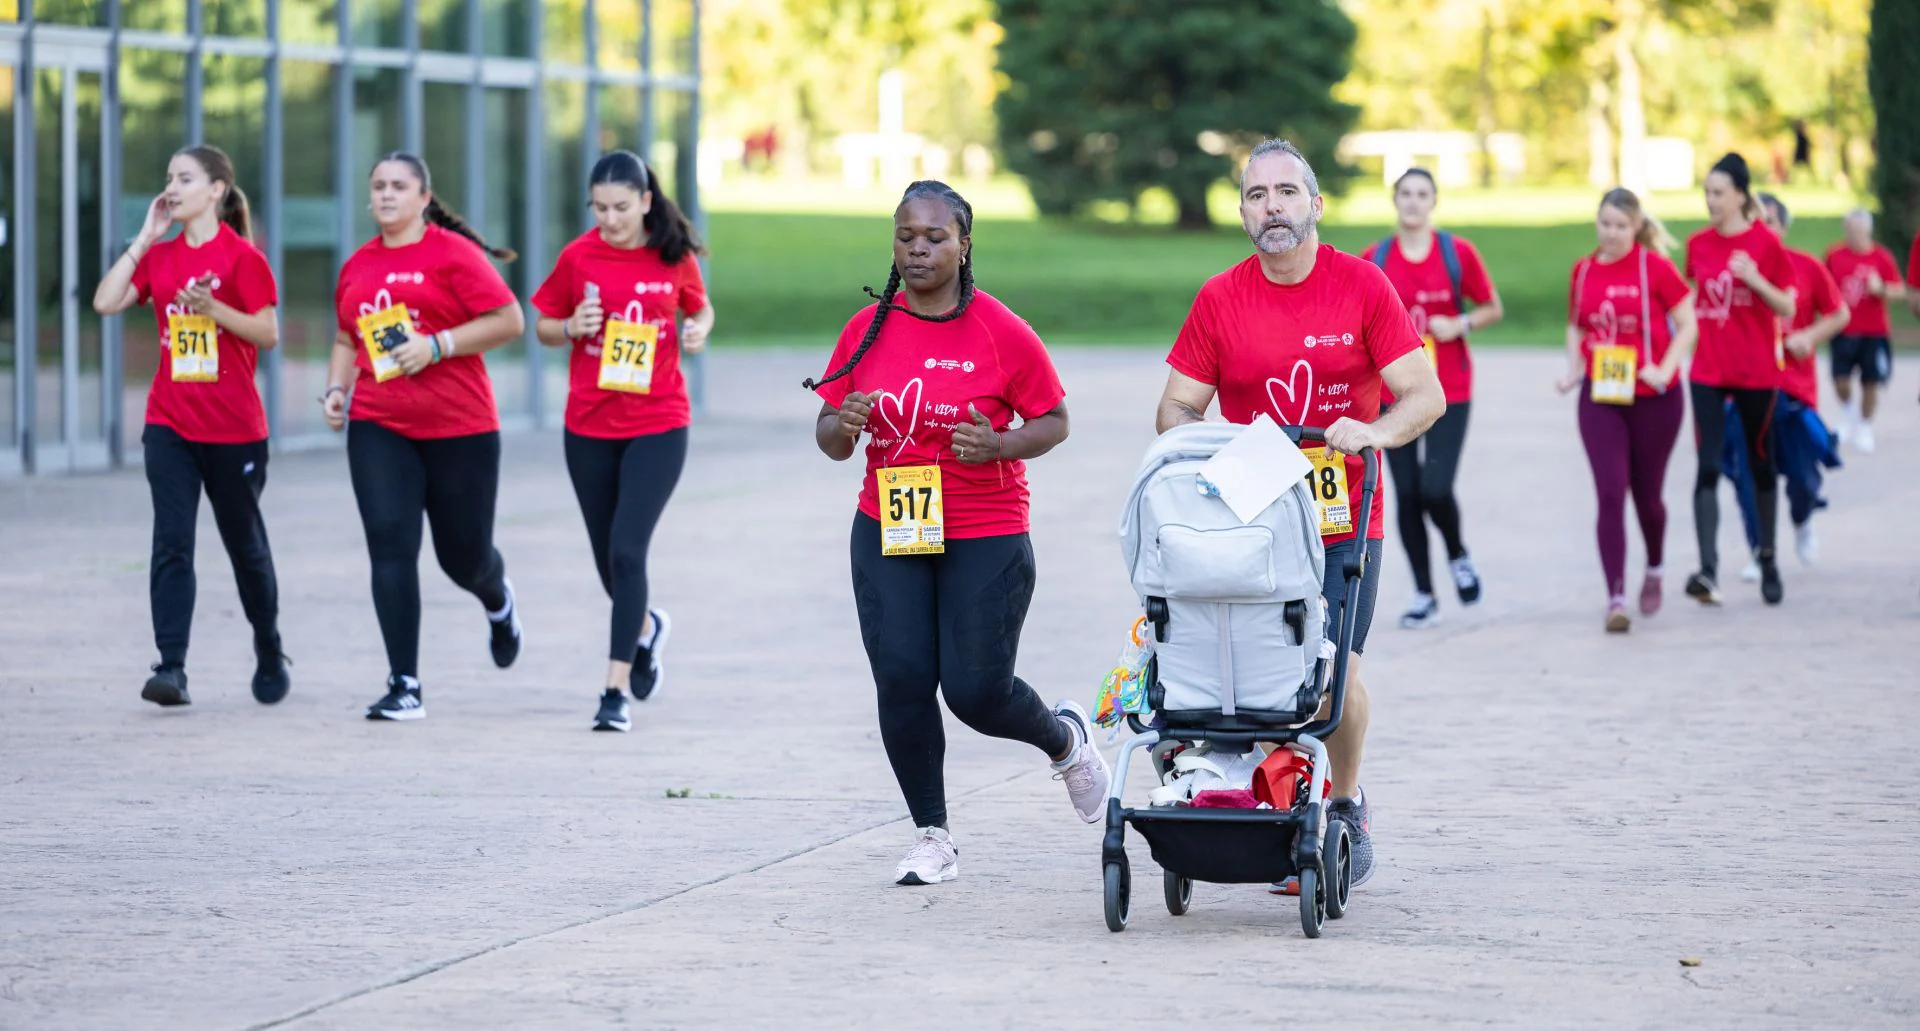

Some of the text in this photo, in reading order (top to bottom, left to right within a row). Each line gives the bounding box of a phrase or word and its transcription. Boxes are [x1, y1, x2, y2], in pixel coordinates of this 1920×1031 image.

[178, 331, 208, 355] 571
[611, 338, 647, 366] 572
[1318, 383, 1349, 396] la VIDA
[925, 401, 959, 417] la VIDA
[1318, 400, 1352, 412] sabe mejor
[924, 419, 939, 428] sabe
[1304, 467, 1337, 501] 18
[889, 487, 932, 521] 517
